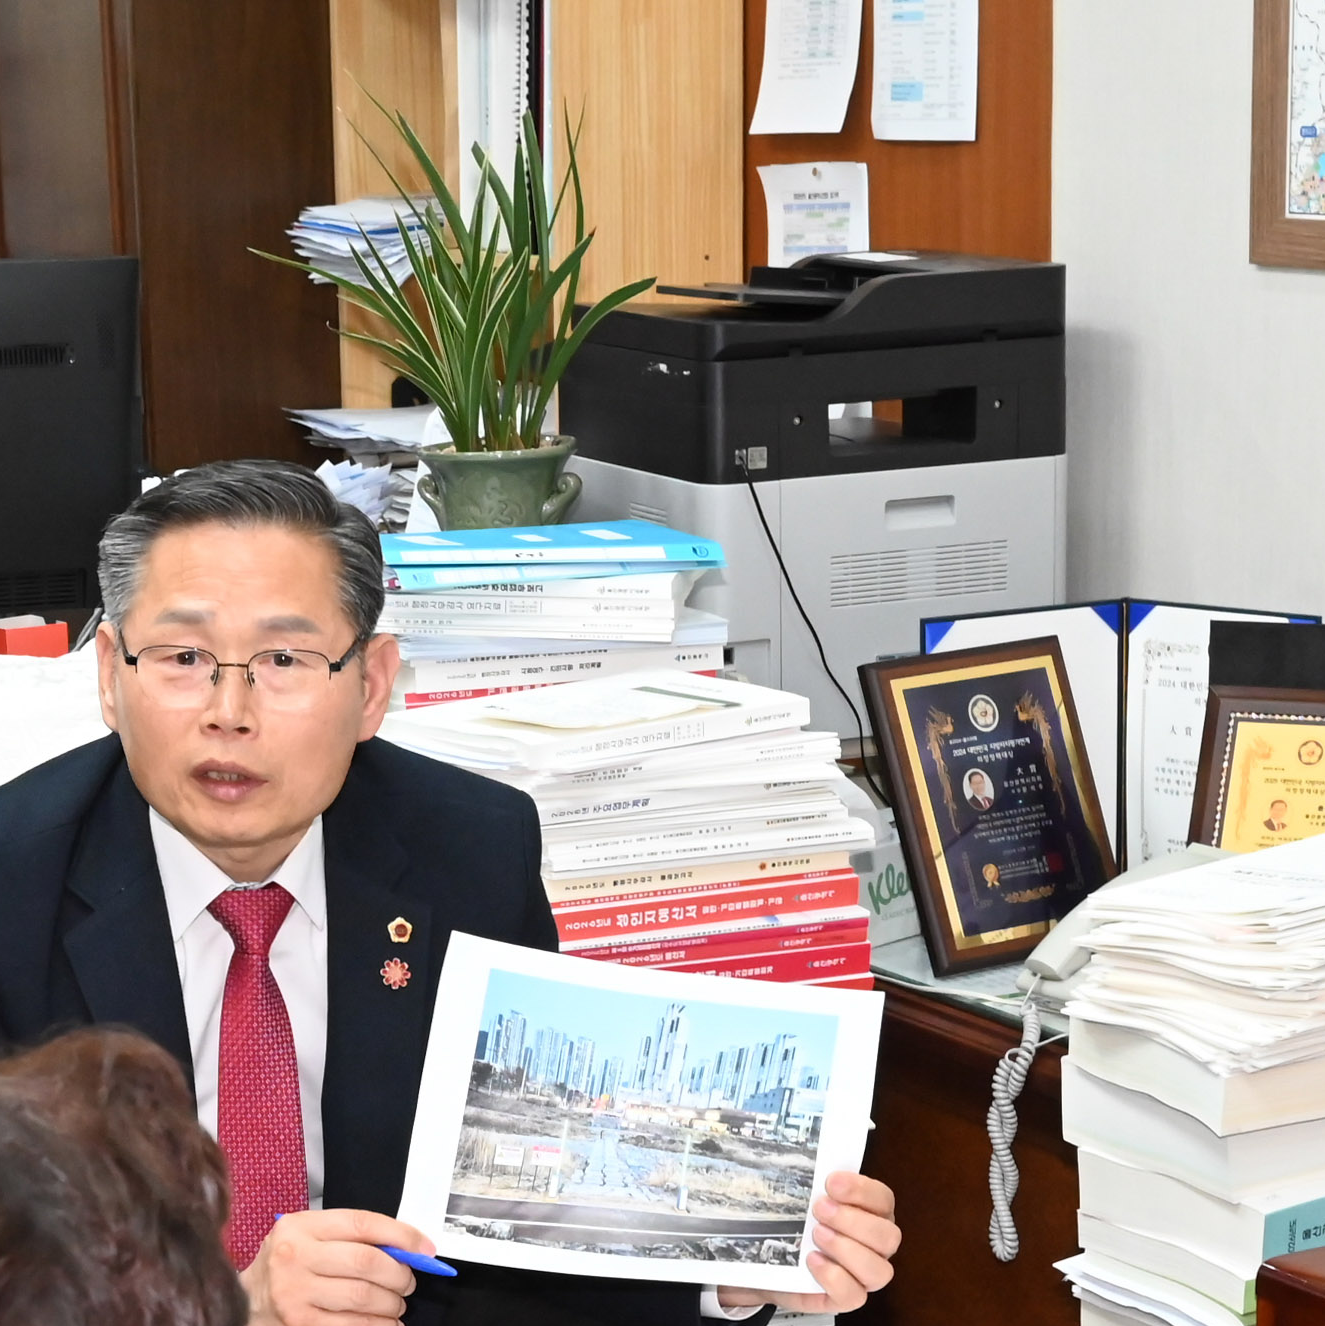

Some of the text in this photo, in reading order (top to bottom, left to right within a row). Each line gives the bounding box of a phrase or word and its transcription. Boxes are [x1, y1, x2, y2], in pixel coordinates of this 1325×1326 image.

[868, 863, 909, 915] Kle
[565, 917, 611, 931] 2026년도
[616, 905, 697, 928] 성인지예산서
[1288, 1218, 1297, 1254] 026년도
